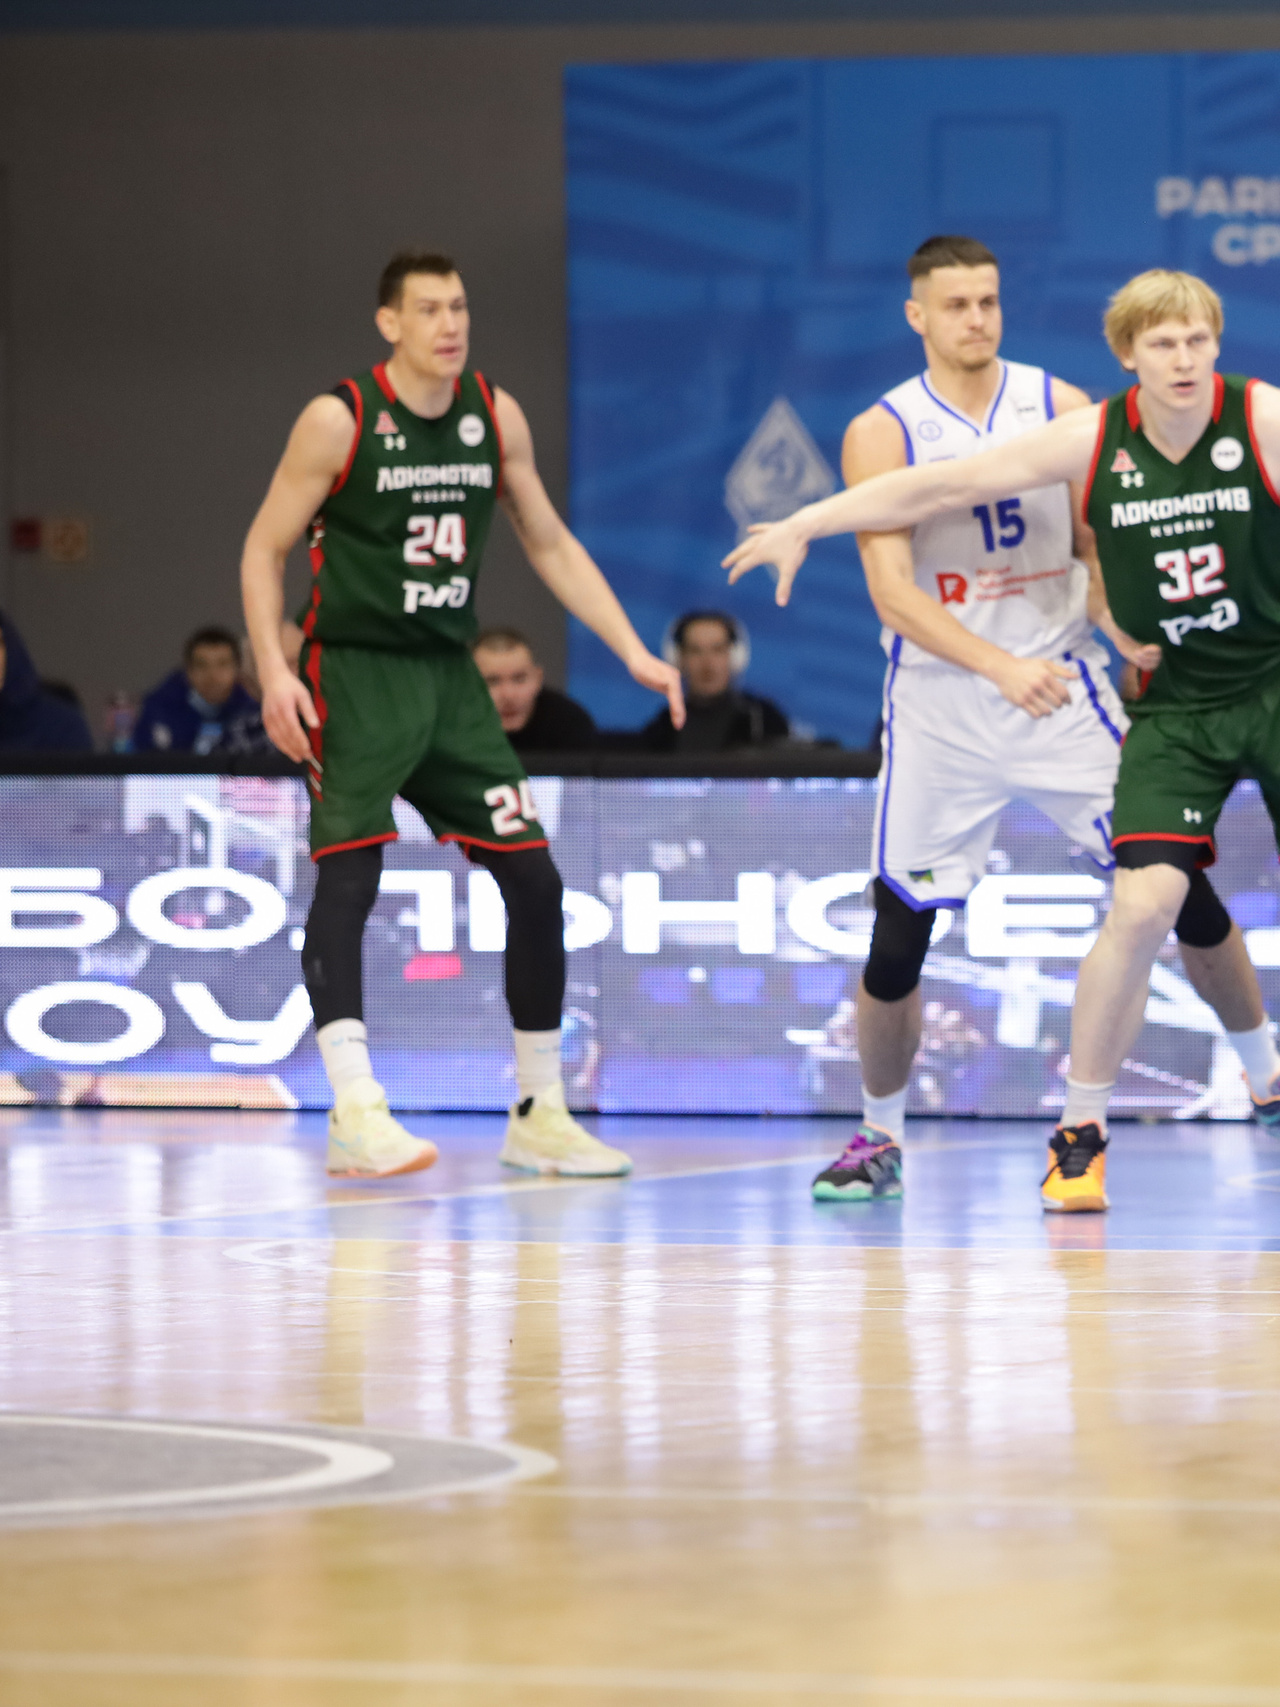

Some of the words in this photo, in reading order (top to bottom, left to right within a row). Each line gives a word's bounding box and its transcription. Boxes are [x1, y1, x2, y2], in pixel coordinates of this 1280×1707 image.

[972, 497, 1026, 553] 15
[1111, 486, 1251, 528] ЛОКОМОТИВ
[403, 513, 467, 565] 24
[1154, 543, 1228, 602] 32
